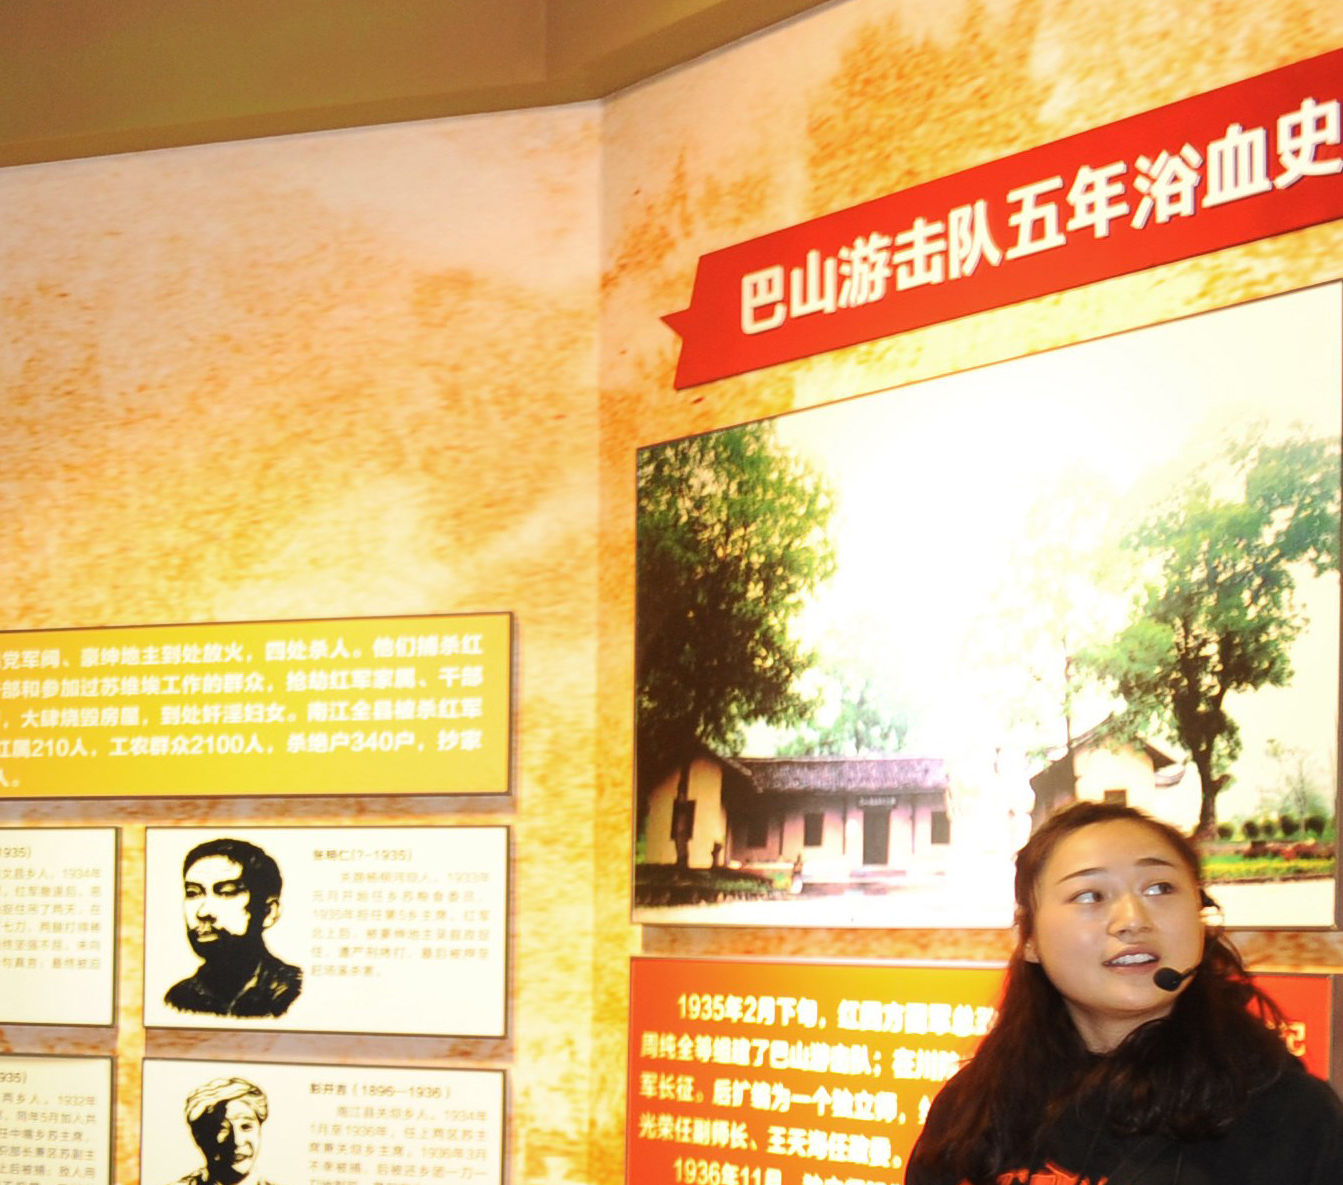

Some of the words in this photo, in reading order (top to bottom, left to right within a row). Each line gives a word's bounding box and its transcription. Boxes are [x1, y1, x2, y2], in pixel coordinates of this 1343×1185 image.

[739, 96, 1343, 336] 巴山游击队五年浴血史
